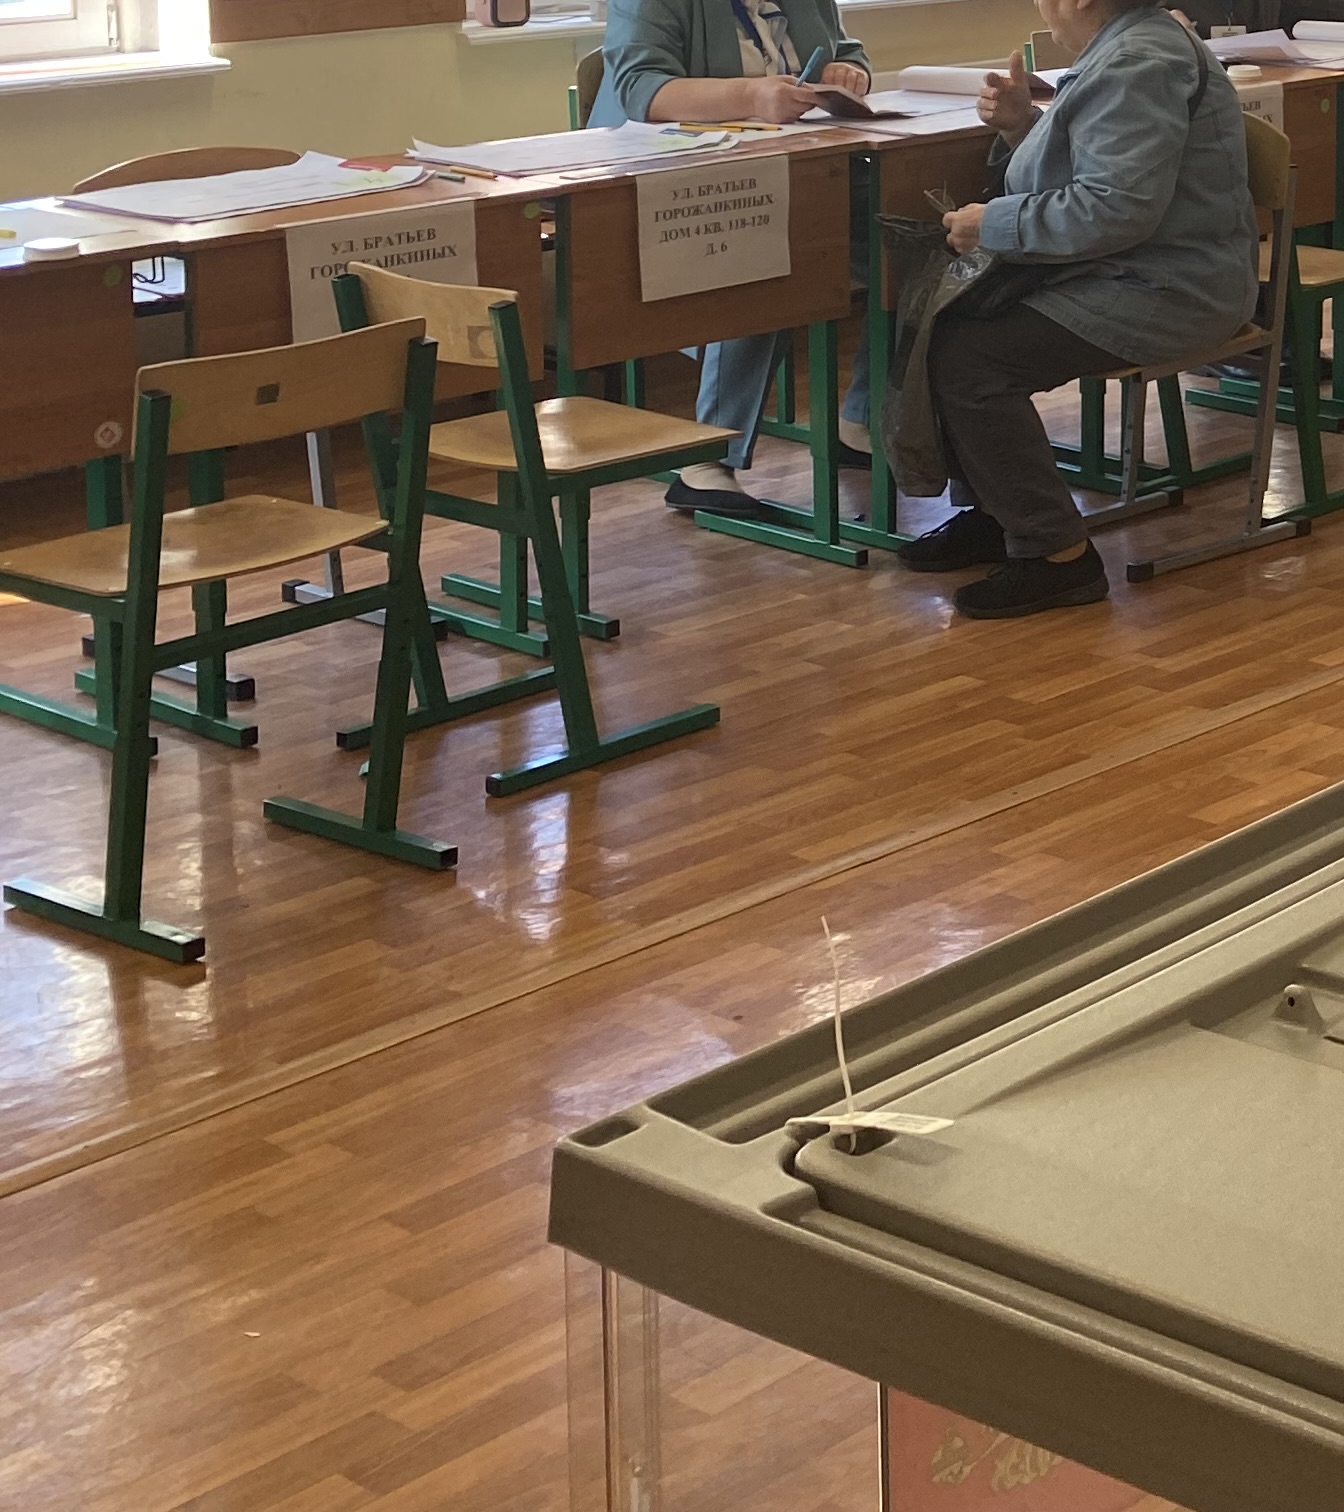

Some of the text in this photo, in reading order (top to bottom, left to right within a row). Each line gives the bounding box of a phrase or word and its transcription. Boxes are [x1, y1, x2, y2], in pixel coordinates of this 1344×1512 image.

[672, 178, 757, 201] УЛ. БРАТЬЕВ
[654, 193, 775, 223] ГОРОЖАНКИНЫХ
[330, 227, 437, 255] УЛ. БРАТЬЕВ
[659, 214, 770, 244] ДОМ 4 КВ. 118-120
[310, 244, 459, 280] ГОРАНКИНЫХ
[705, 240, 728, 257] Д. 6
